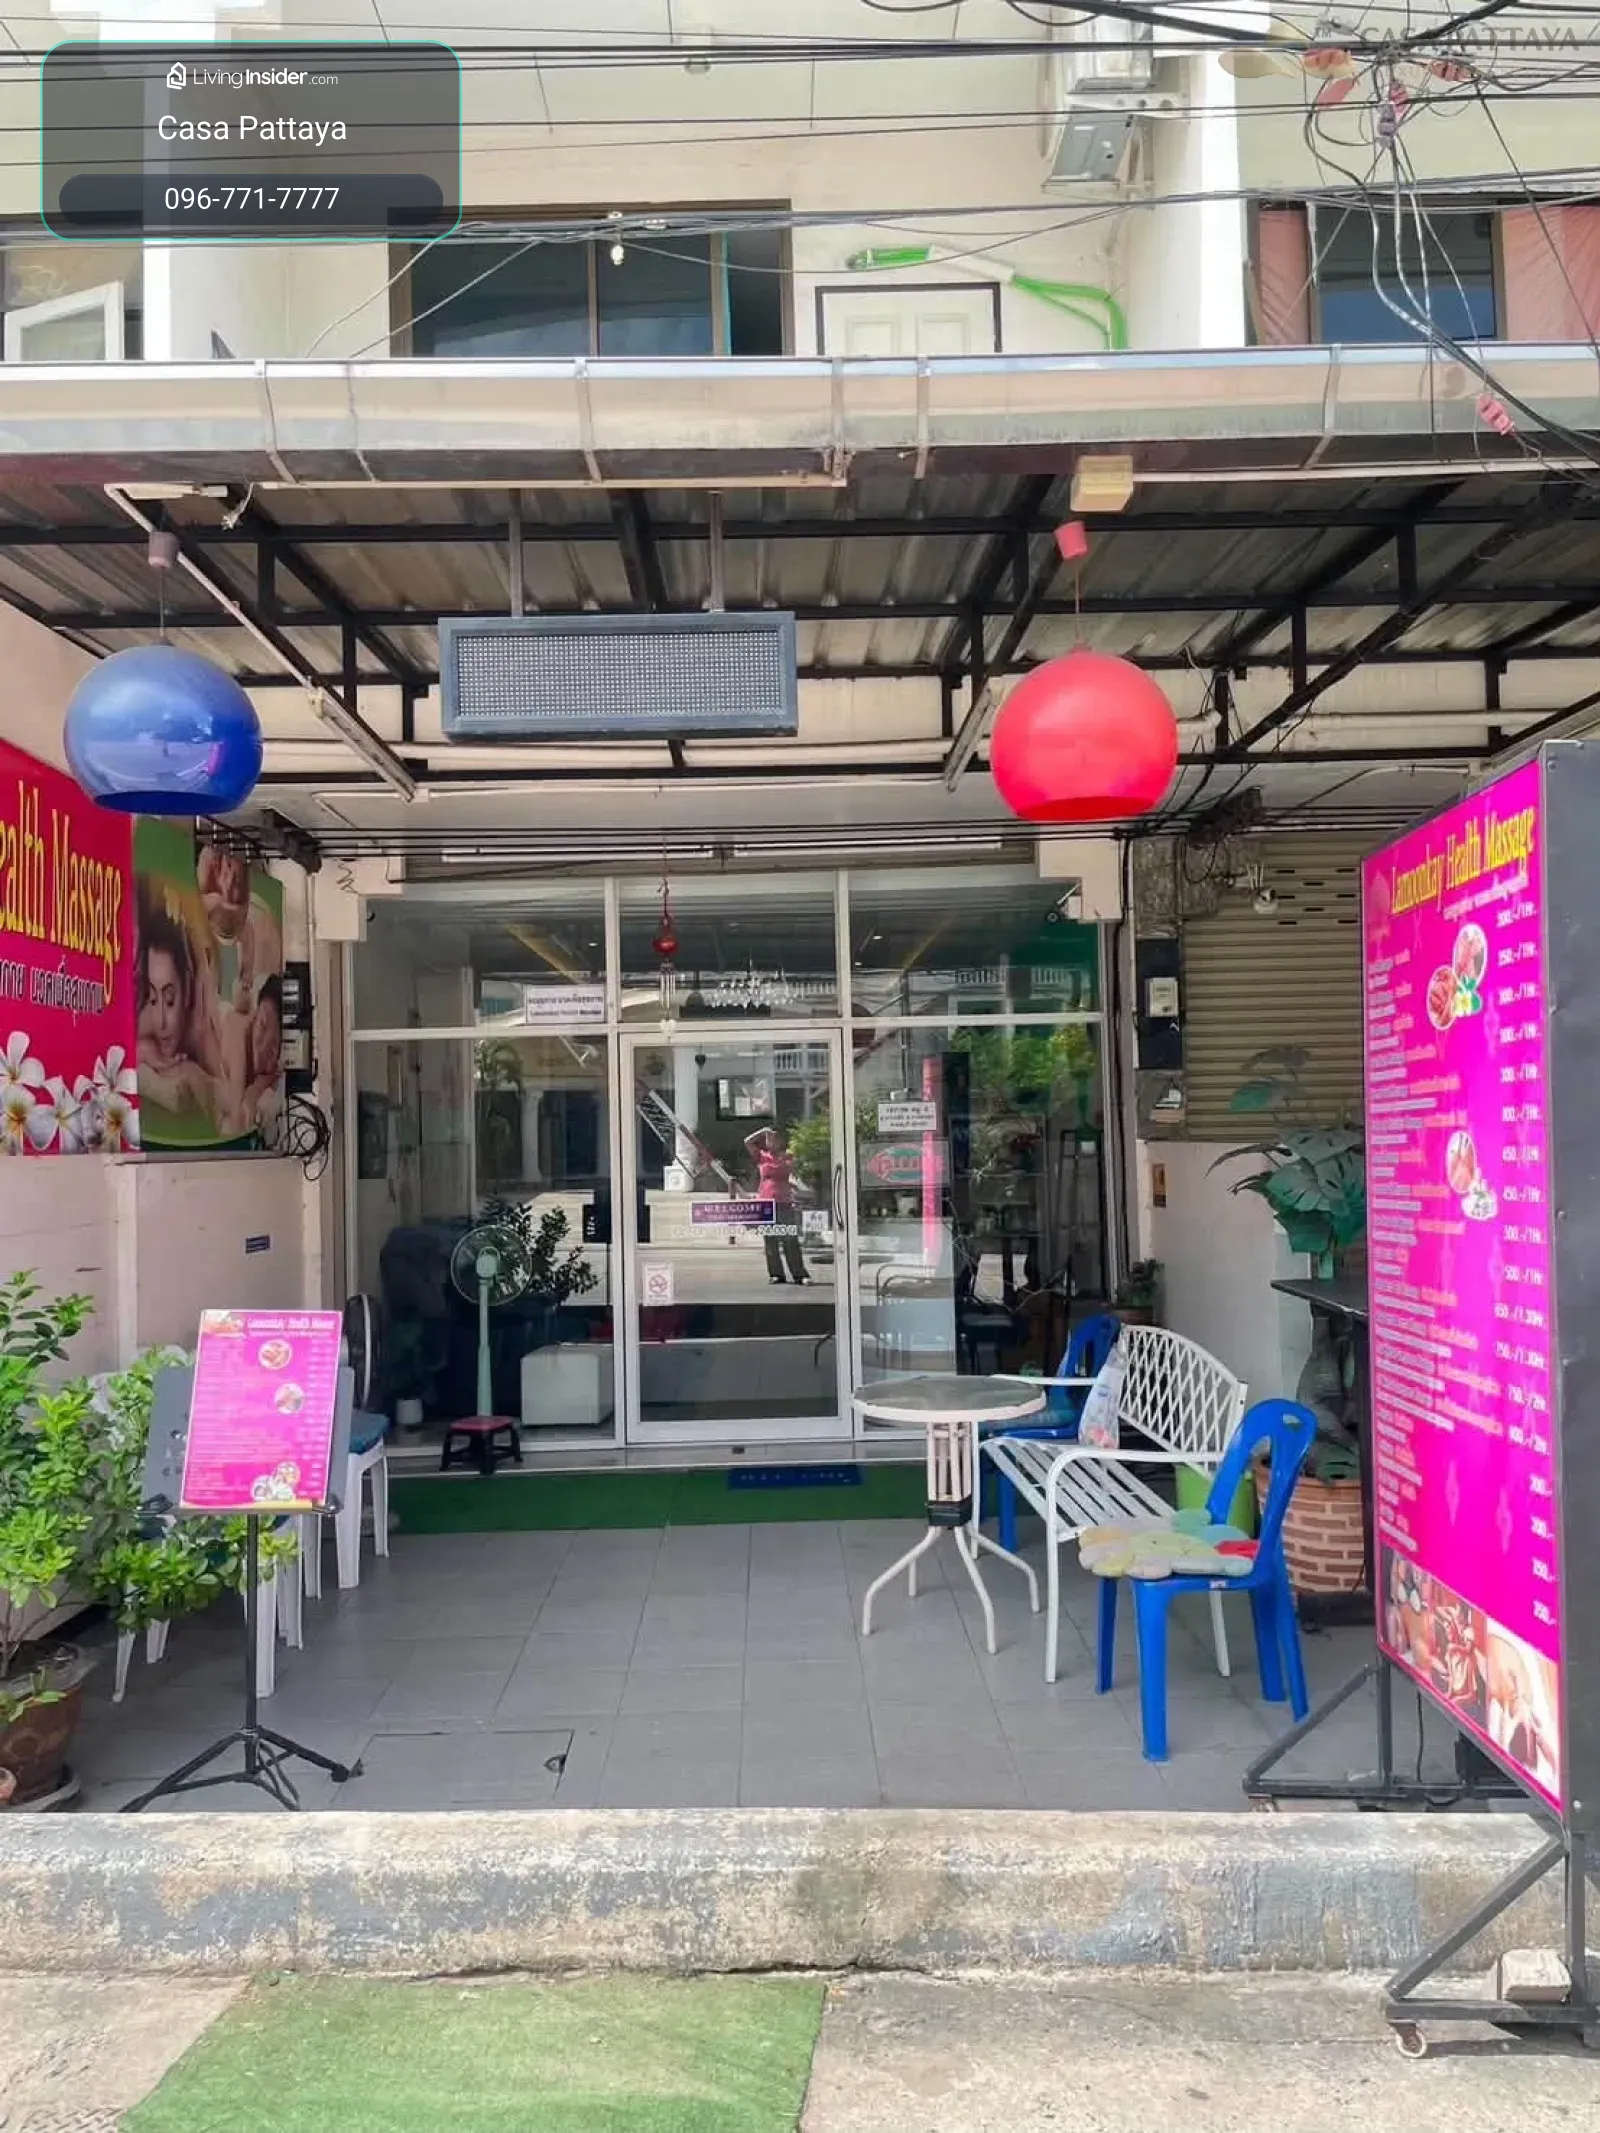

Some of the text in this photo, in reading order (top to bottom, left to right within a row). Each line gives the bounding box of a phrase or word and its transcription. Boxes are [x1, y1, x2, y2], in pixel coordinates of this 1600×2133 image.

[51, 809, 121, 1005] Massage
[1446, 815, 1481, 890] Health
[1483, 806, 1534, 876] Massage
